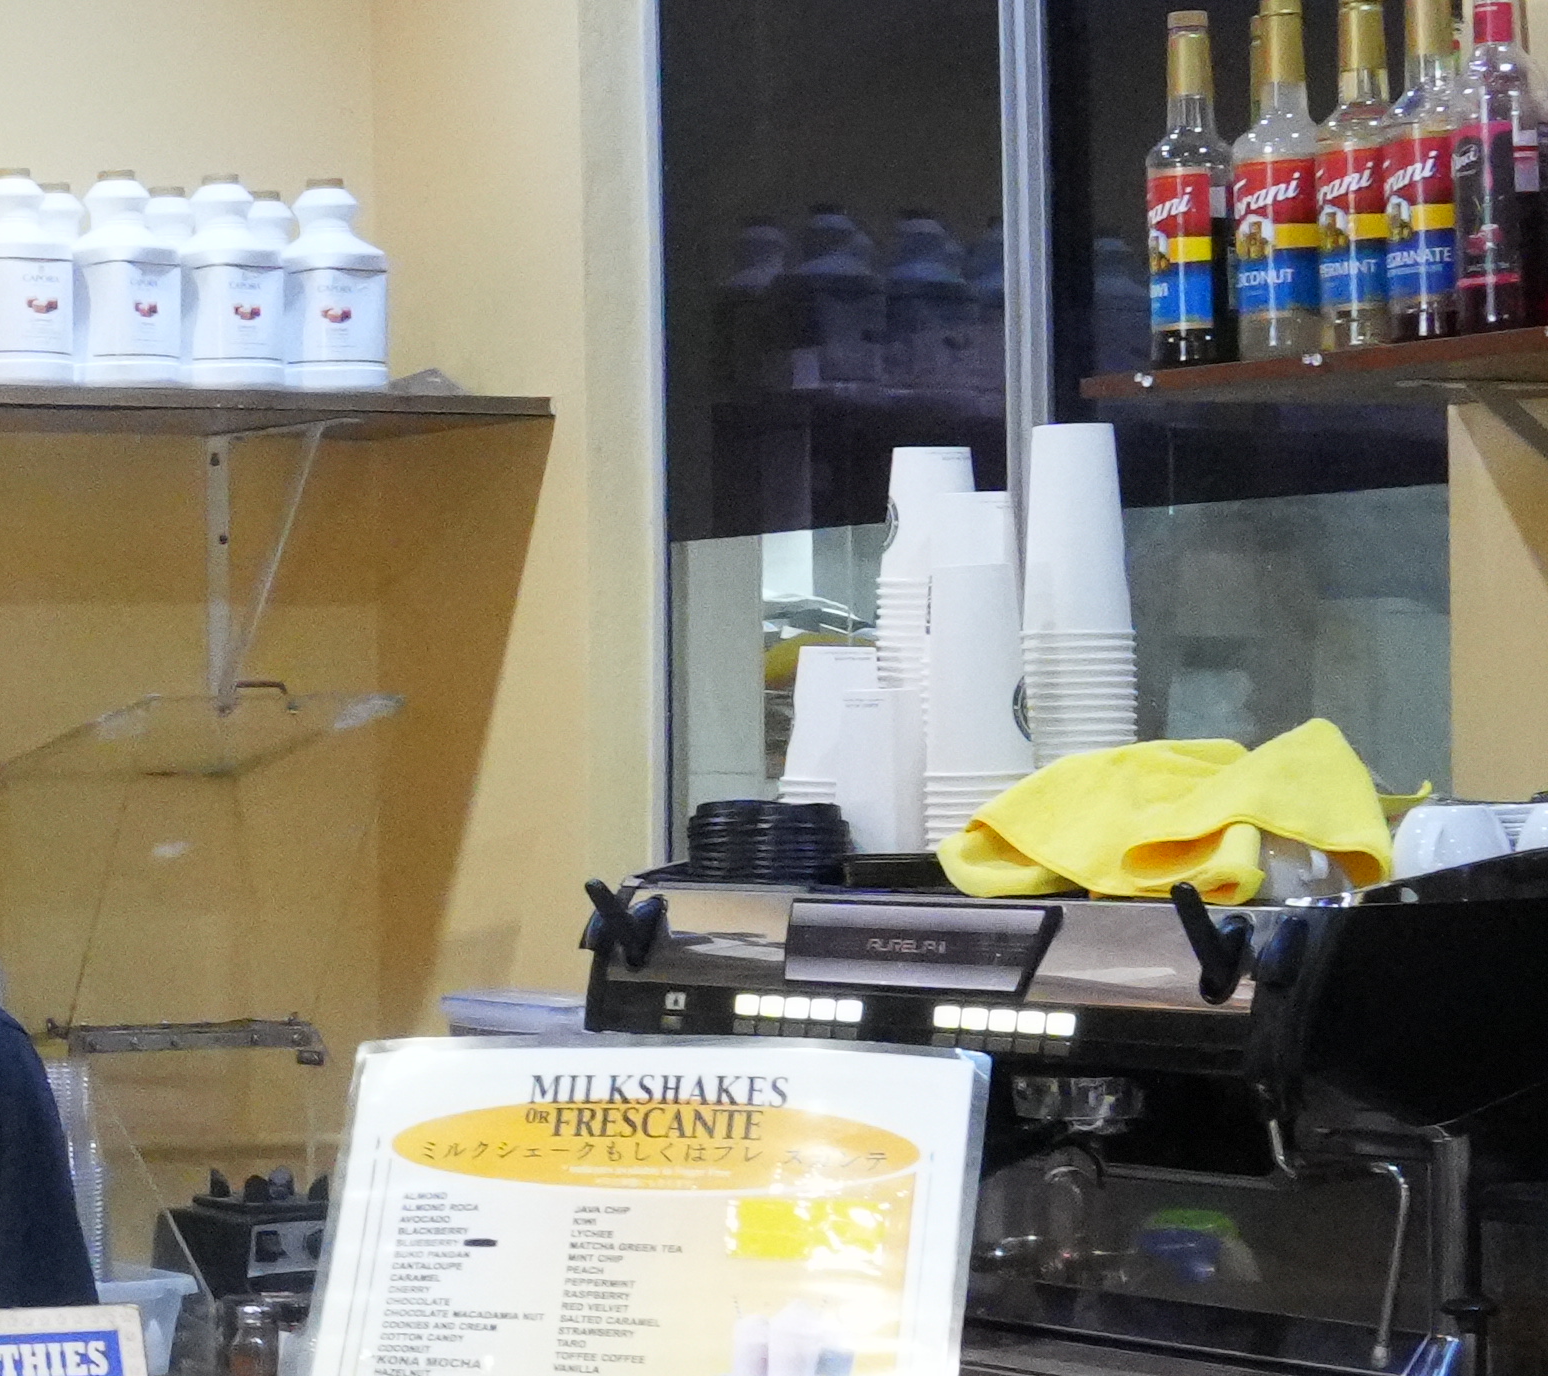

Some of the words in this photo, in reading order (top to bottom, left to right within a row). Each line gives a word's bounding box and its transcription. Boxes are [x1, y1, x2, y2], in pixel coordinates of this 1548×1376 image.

[531, 1074, 790, 1107] MILKSHAKES
[526, 1108, 549, 1123] OR
[550, 1107, 763, 1140] FRESCANTE
